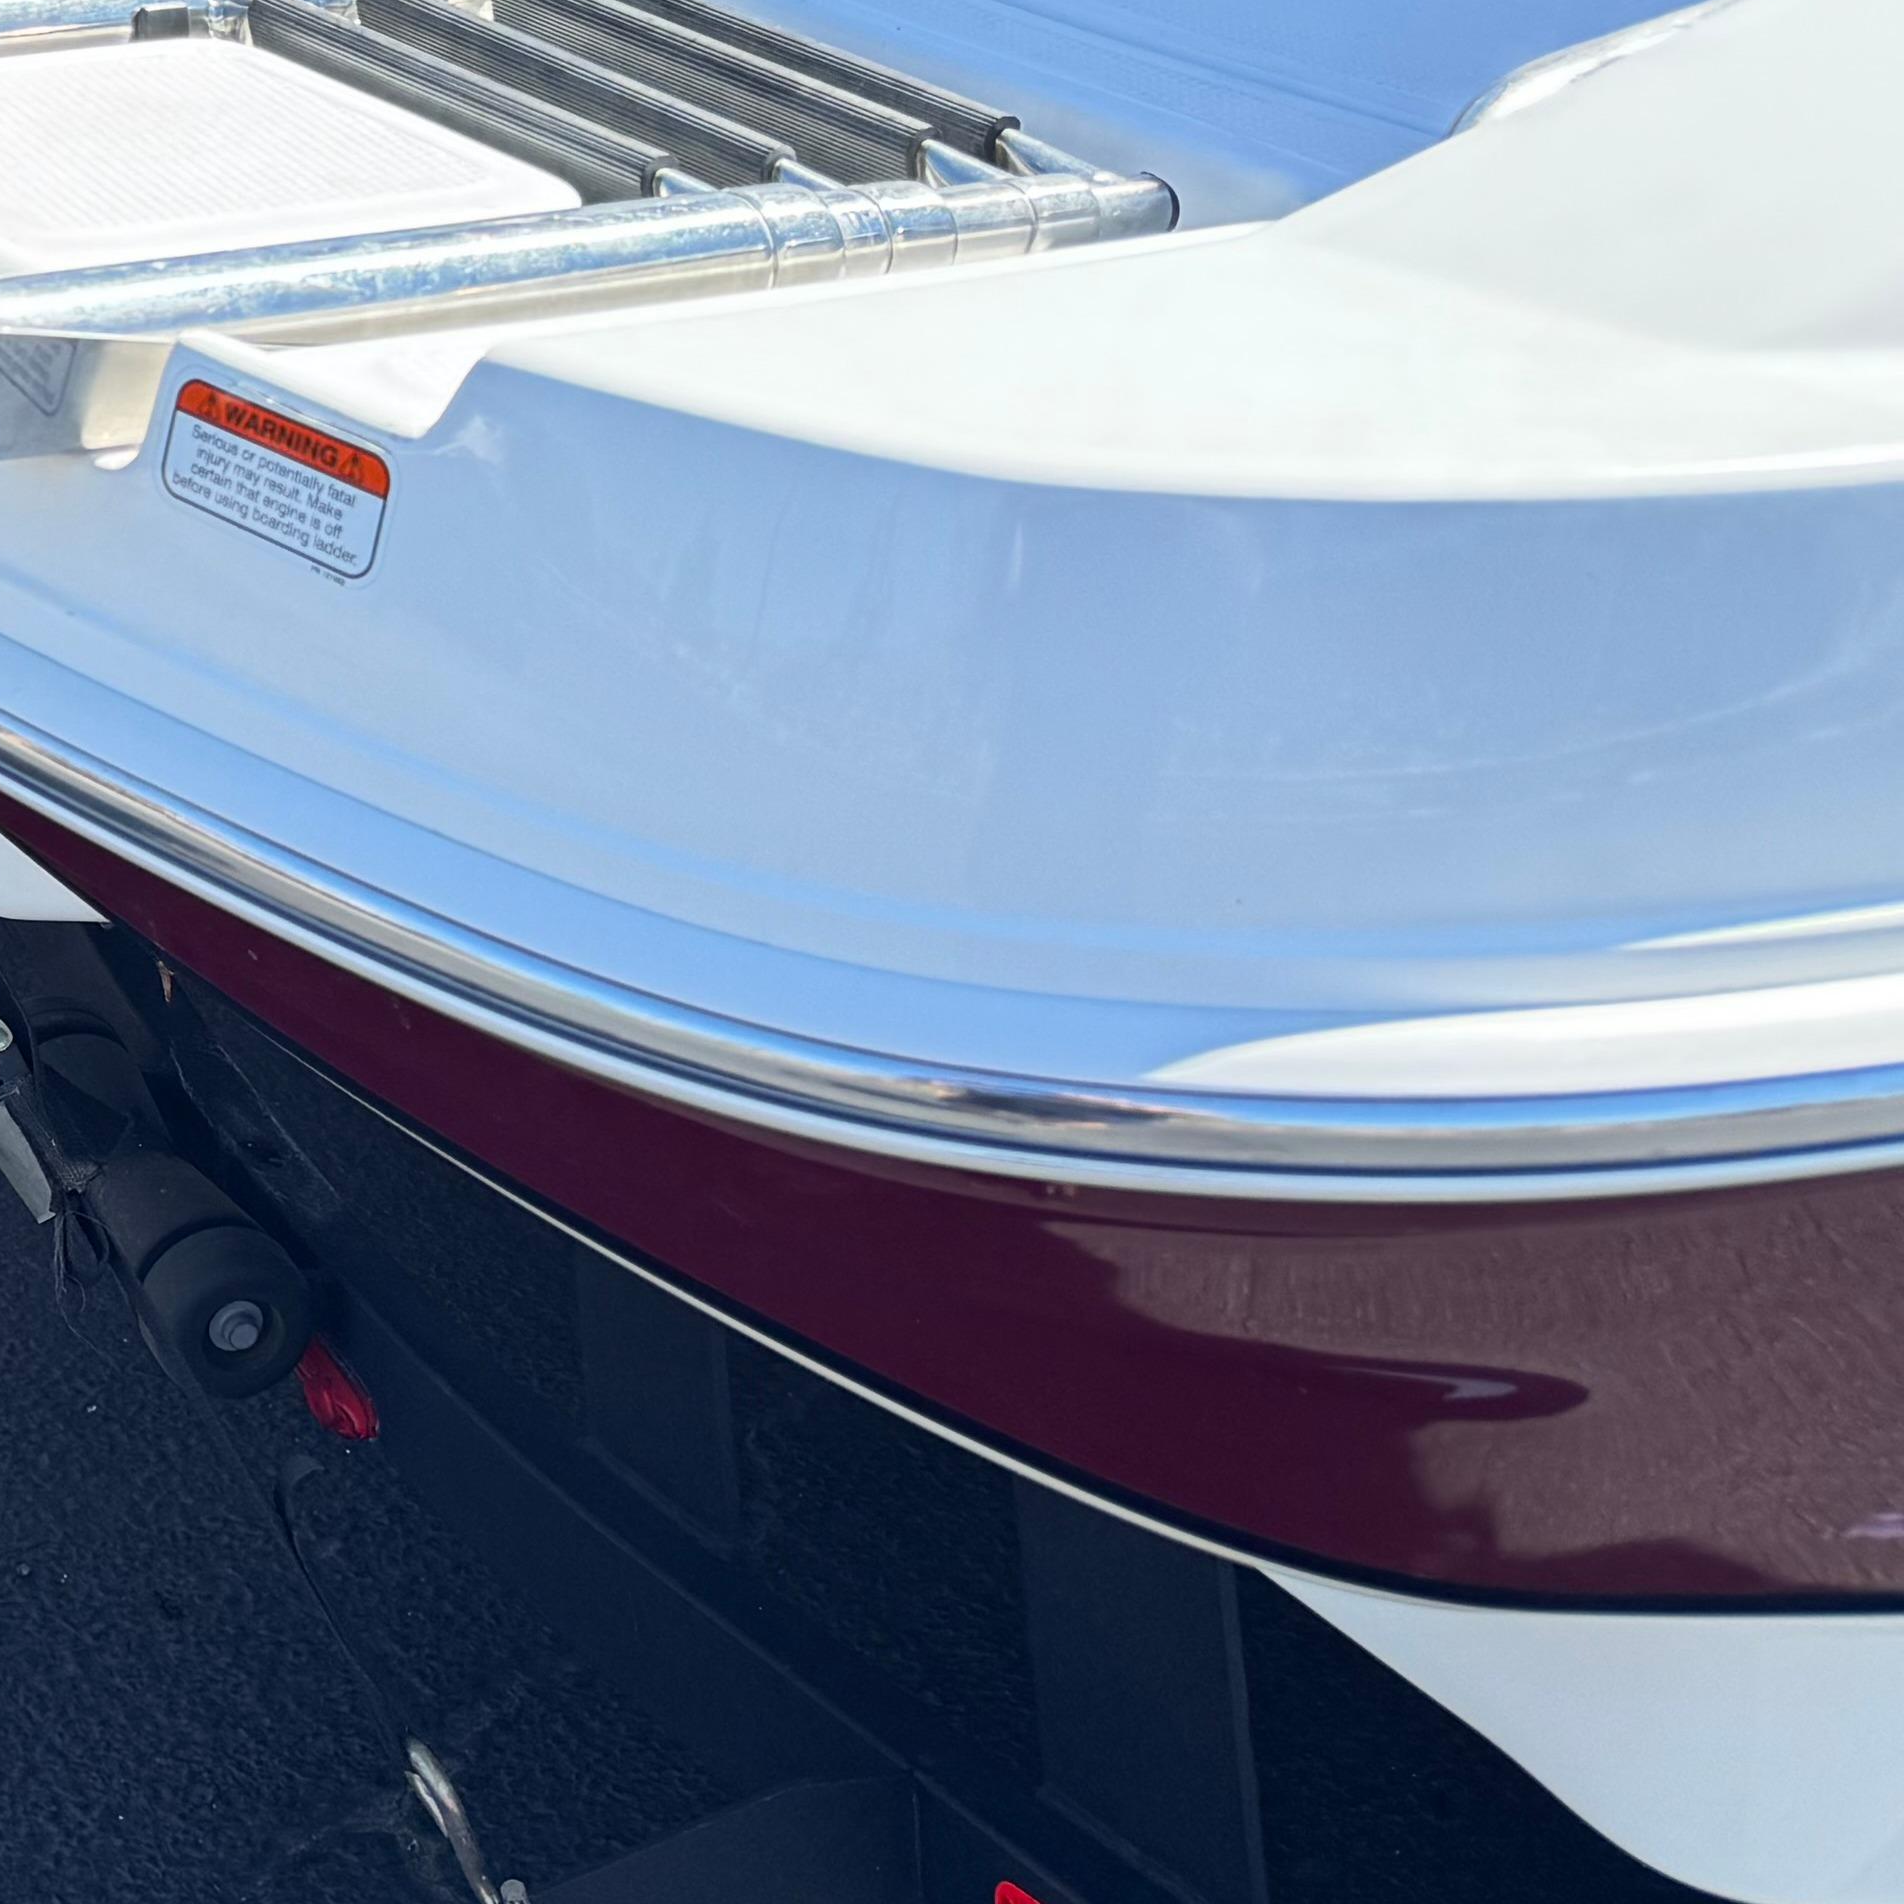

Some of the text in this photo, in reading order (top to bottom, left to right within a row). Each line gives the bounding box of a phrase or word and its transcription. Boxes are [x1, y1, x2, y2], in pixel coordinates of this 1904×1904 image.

[192, 424, 356, 507] Serious or potentially fatal
[227, 406, 337, 467] WARNING
[173, 471, 357, 565] before using boarding ladder.
[191, 464, 342, 538] certain that engine is off
[197, 448, 343, 520] injury may result. Make
